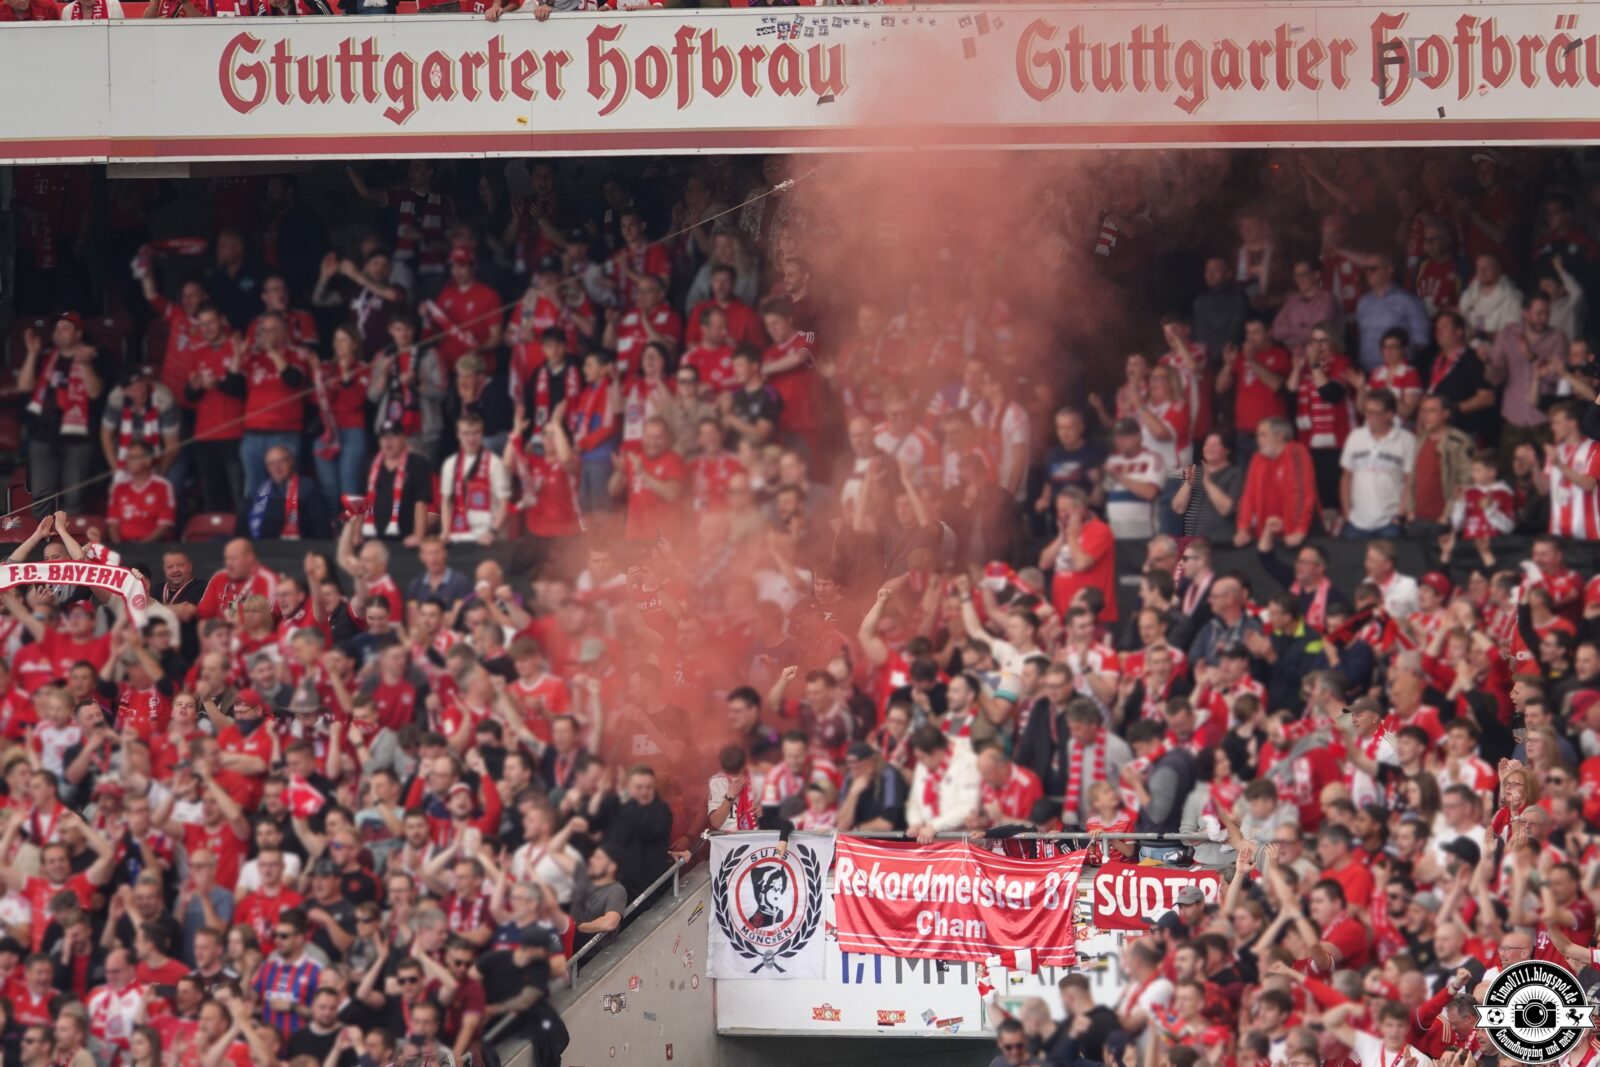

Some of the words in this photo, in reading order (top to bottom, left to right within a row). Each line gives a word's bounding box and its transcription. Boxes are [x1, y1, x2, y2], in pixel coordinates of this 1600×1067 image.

[219, 31, 573, 125] Stuttgarter
[1016, 18, 1357, 114] Stuttgarter
[9, 564, 41, 583] F.C.
[48, 564, 128, 589] BAYERN
[835, 856, 1036, 911] Rekordmeister
[1043, 871, 1078, 911] 87
[916, 911, 987, 939] Cham
